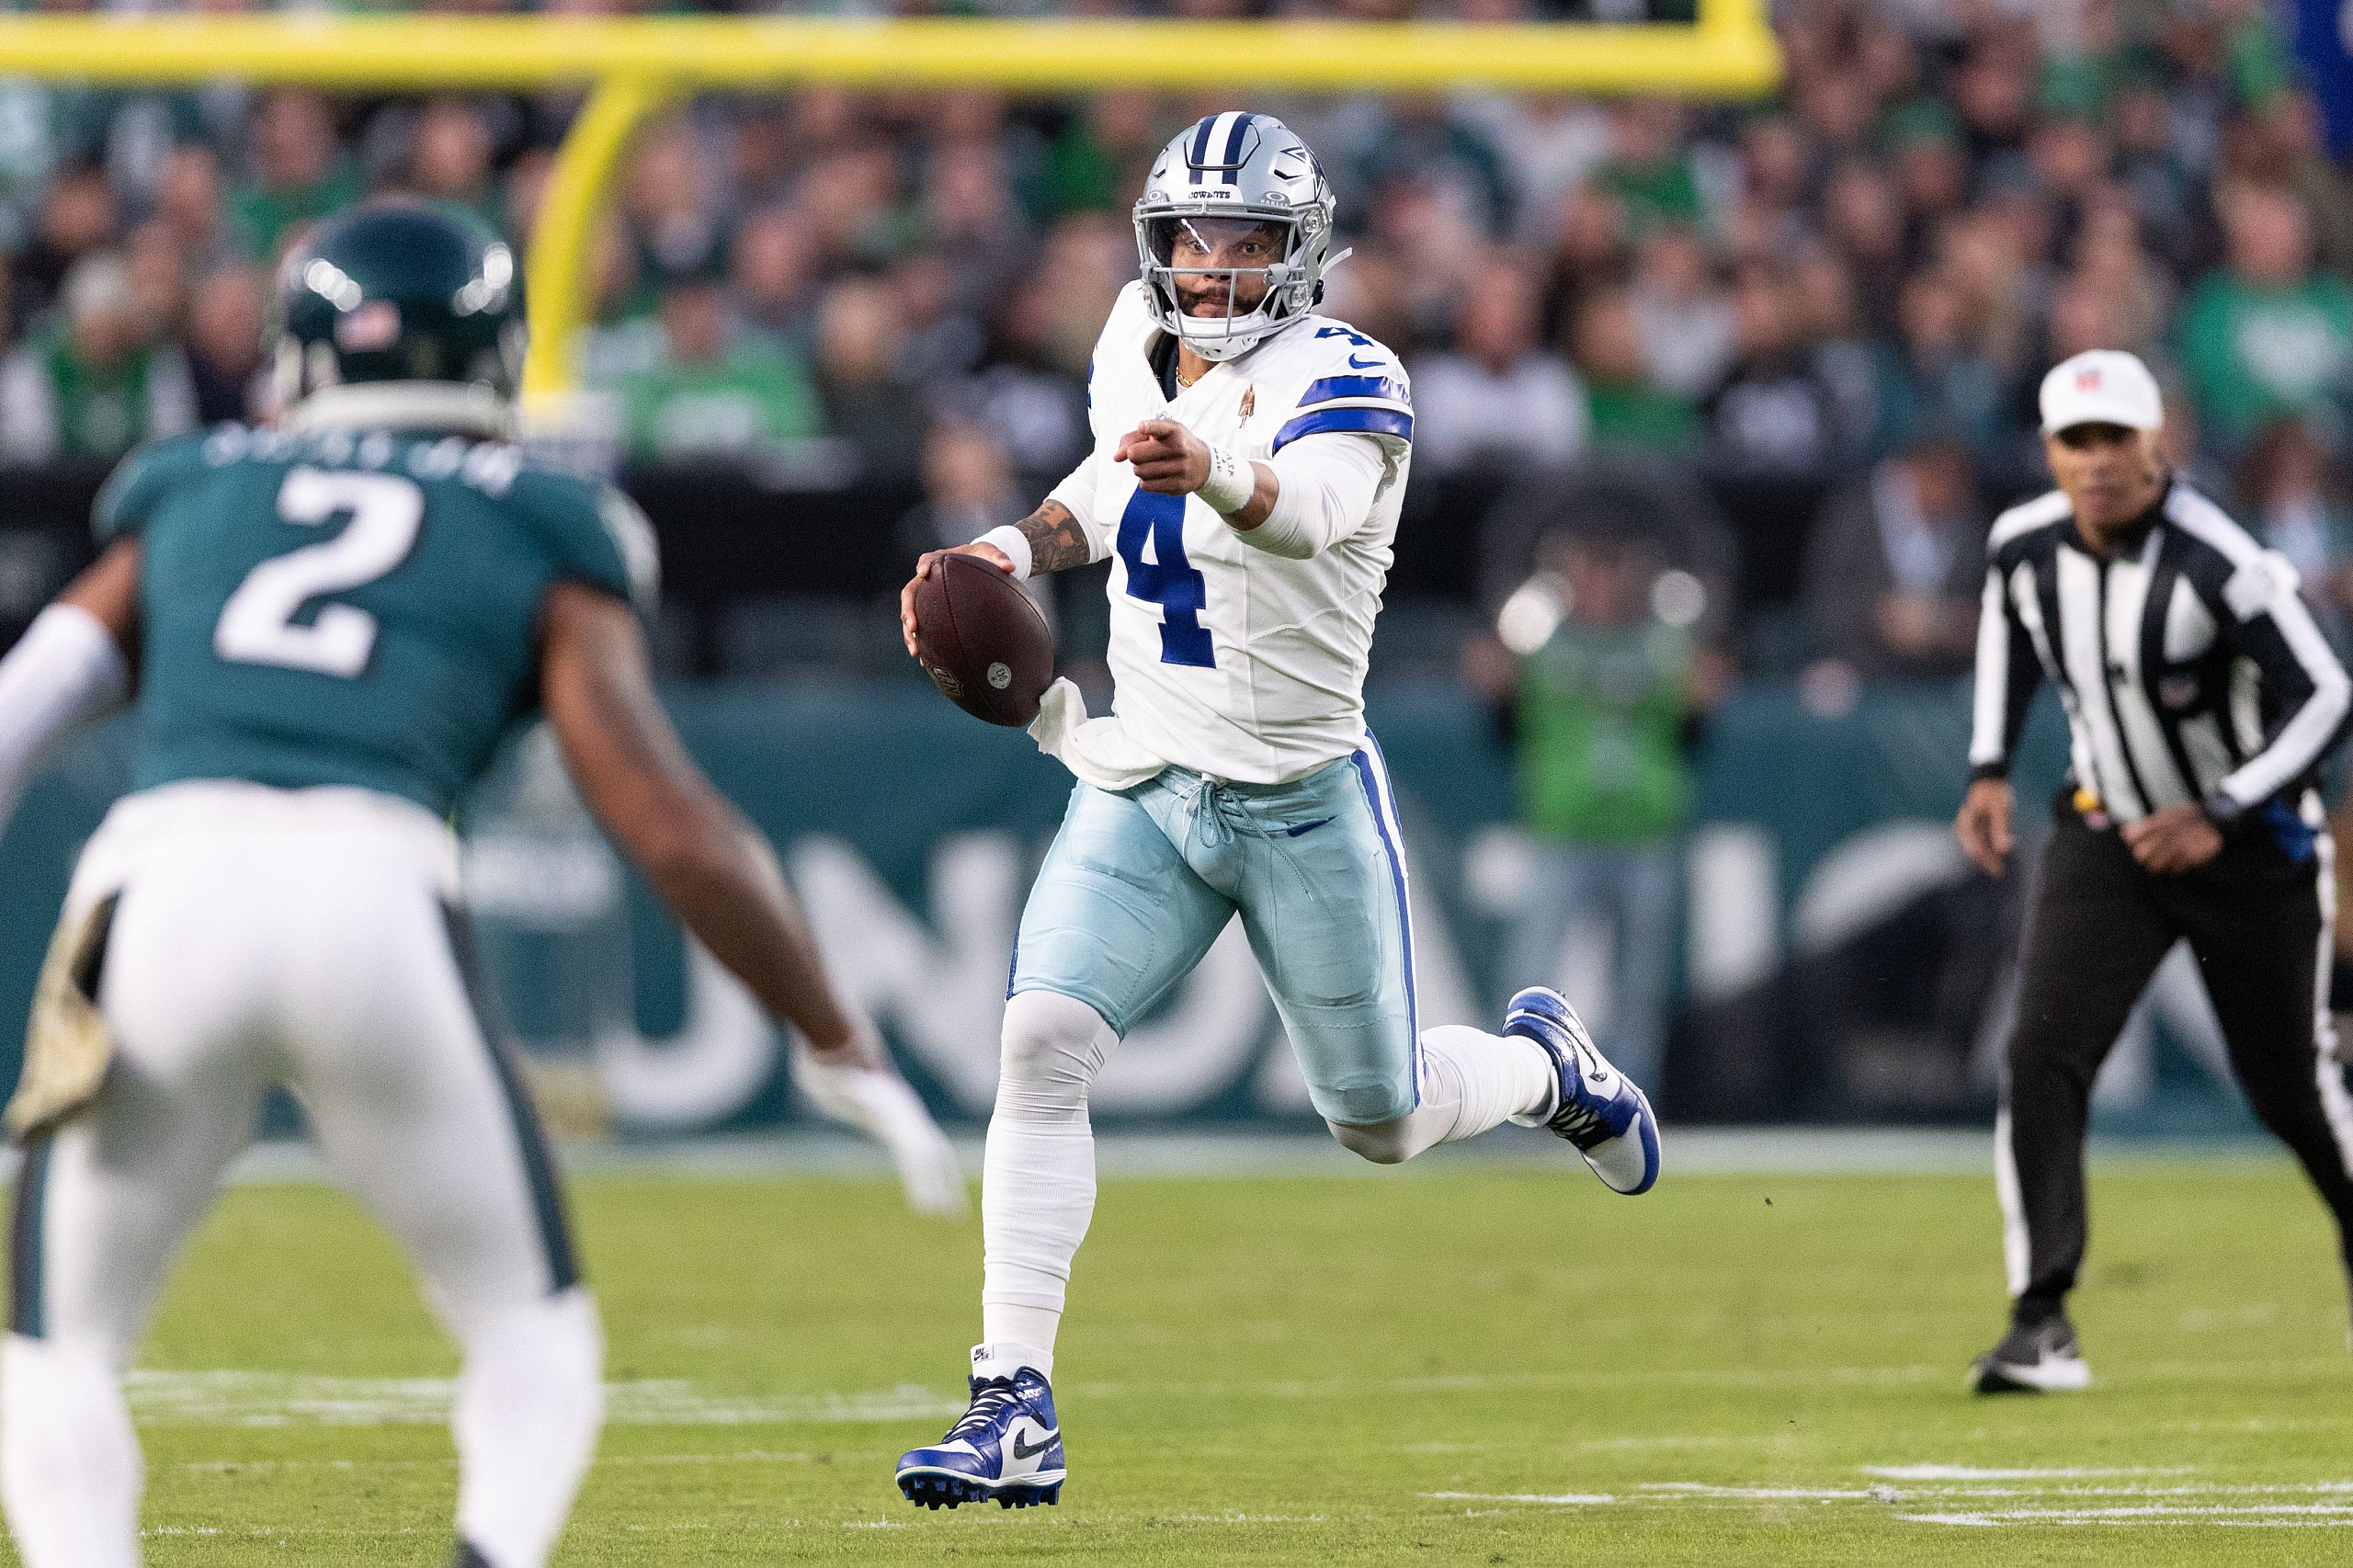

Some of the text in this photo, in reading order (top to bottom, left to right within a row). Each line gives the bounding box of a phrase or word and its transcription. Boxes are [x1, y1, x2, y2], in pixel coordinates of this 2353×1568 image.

[1313, 326, 1376, 347] 4
[215, 465, 426, 679] 2
[1116, 483, 1217, 669] 4
